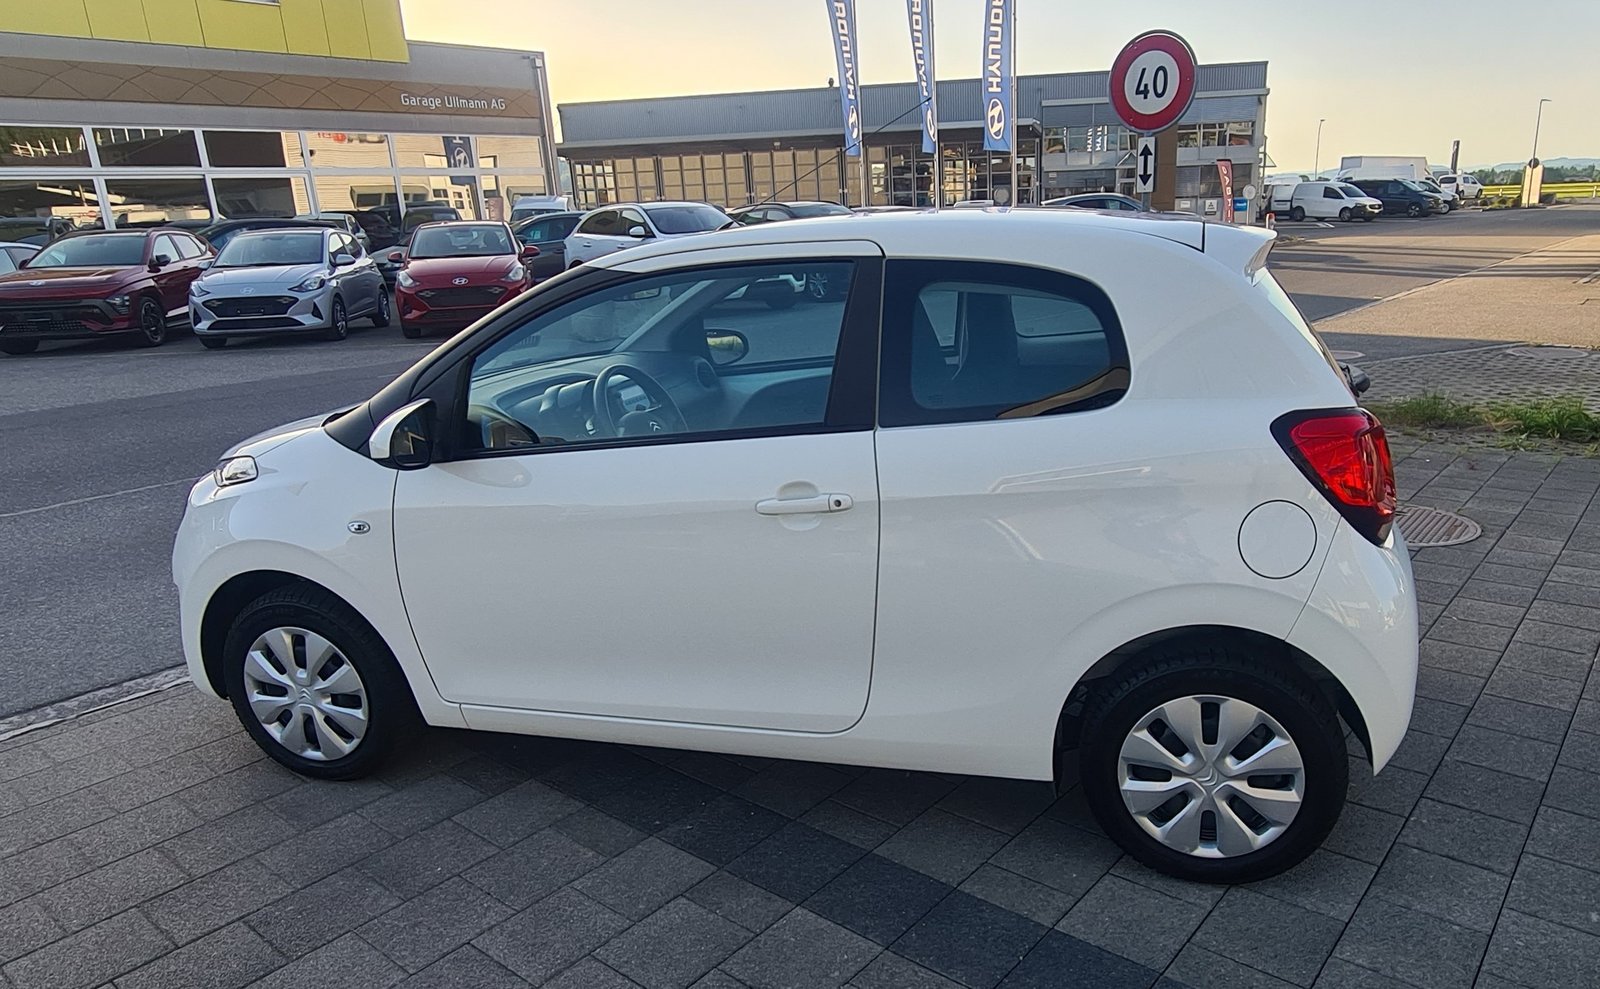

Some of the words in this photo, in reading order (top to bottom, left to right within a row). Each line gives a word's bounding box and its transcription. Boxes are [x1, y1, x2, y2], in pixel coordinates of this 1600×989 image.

[1135, 65, 1169, 100] 40
[400, 93, 442, 109] Garage
[444, 96, 488, 109] Ullmann
[491, 98, 506, 110] AG
